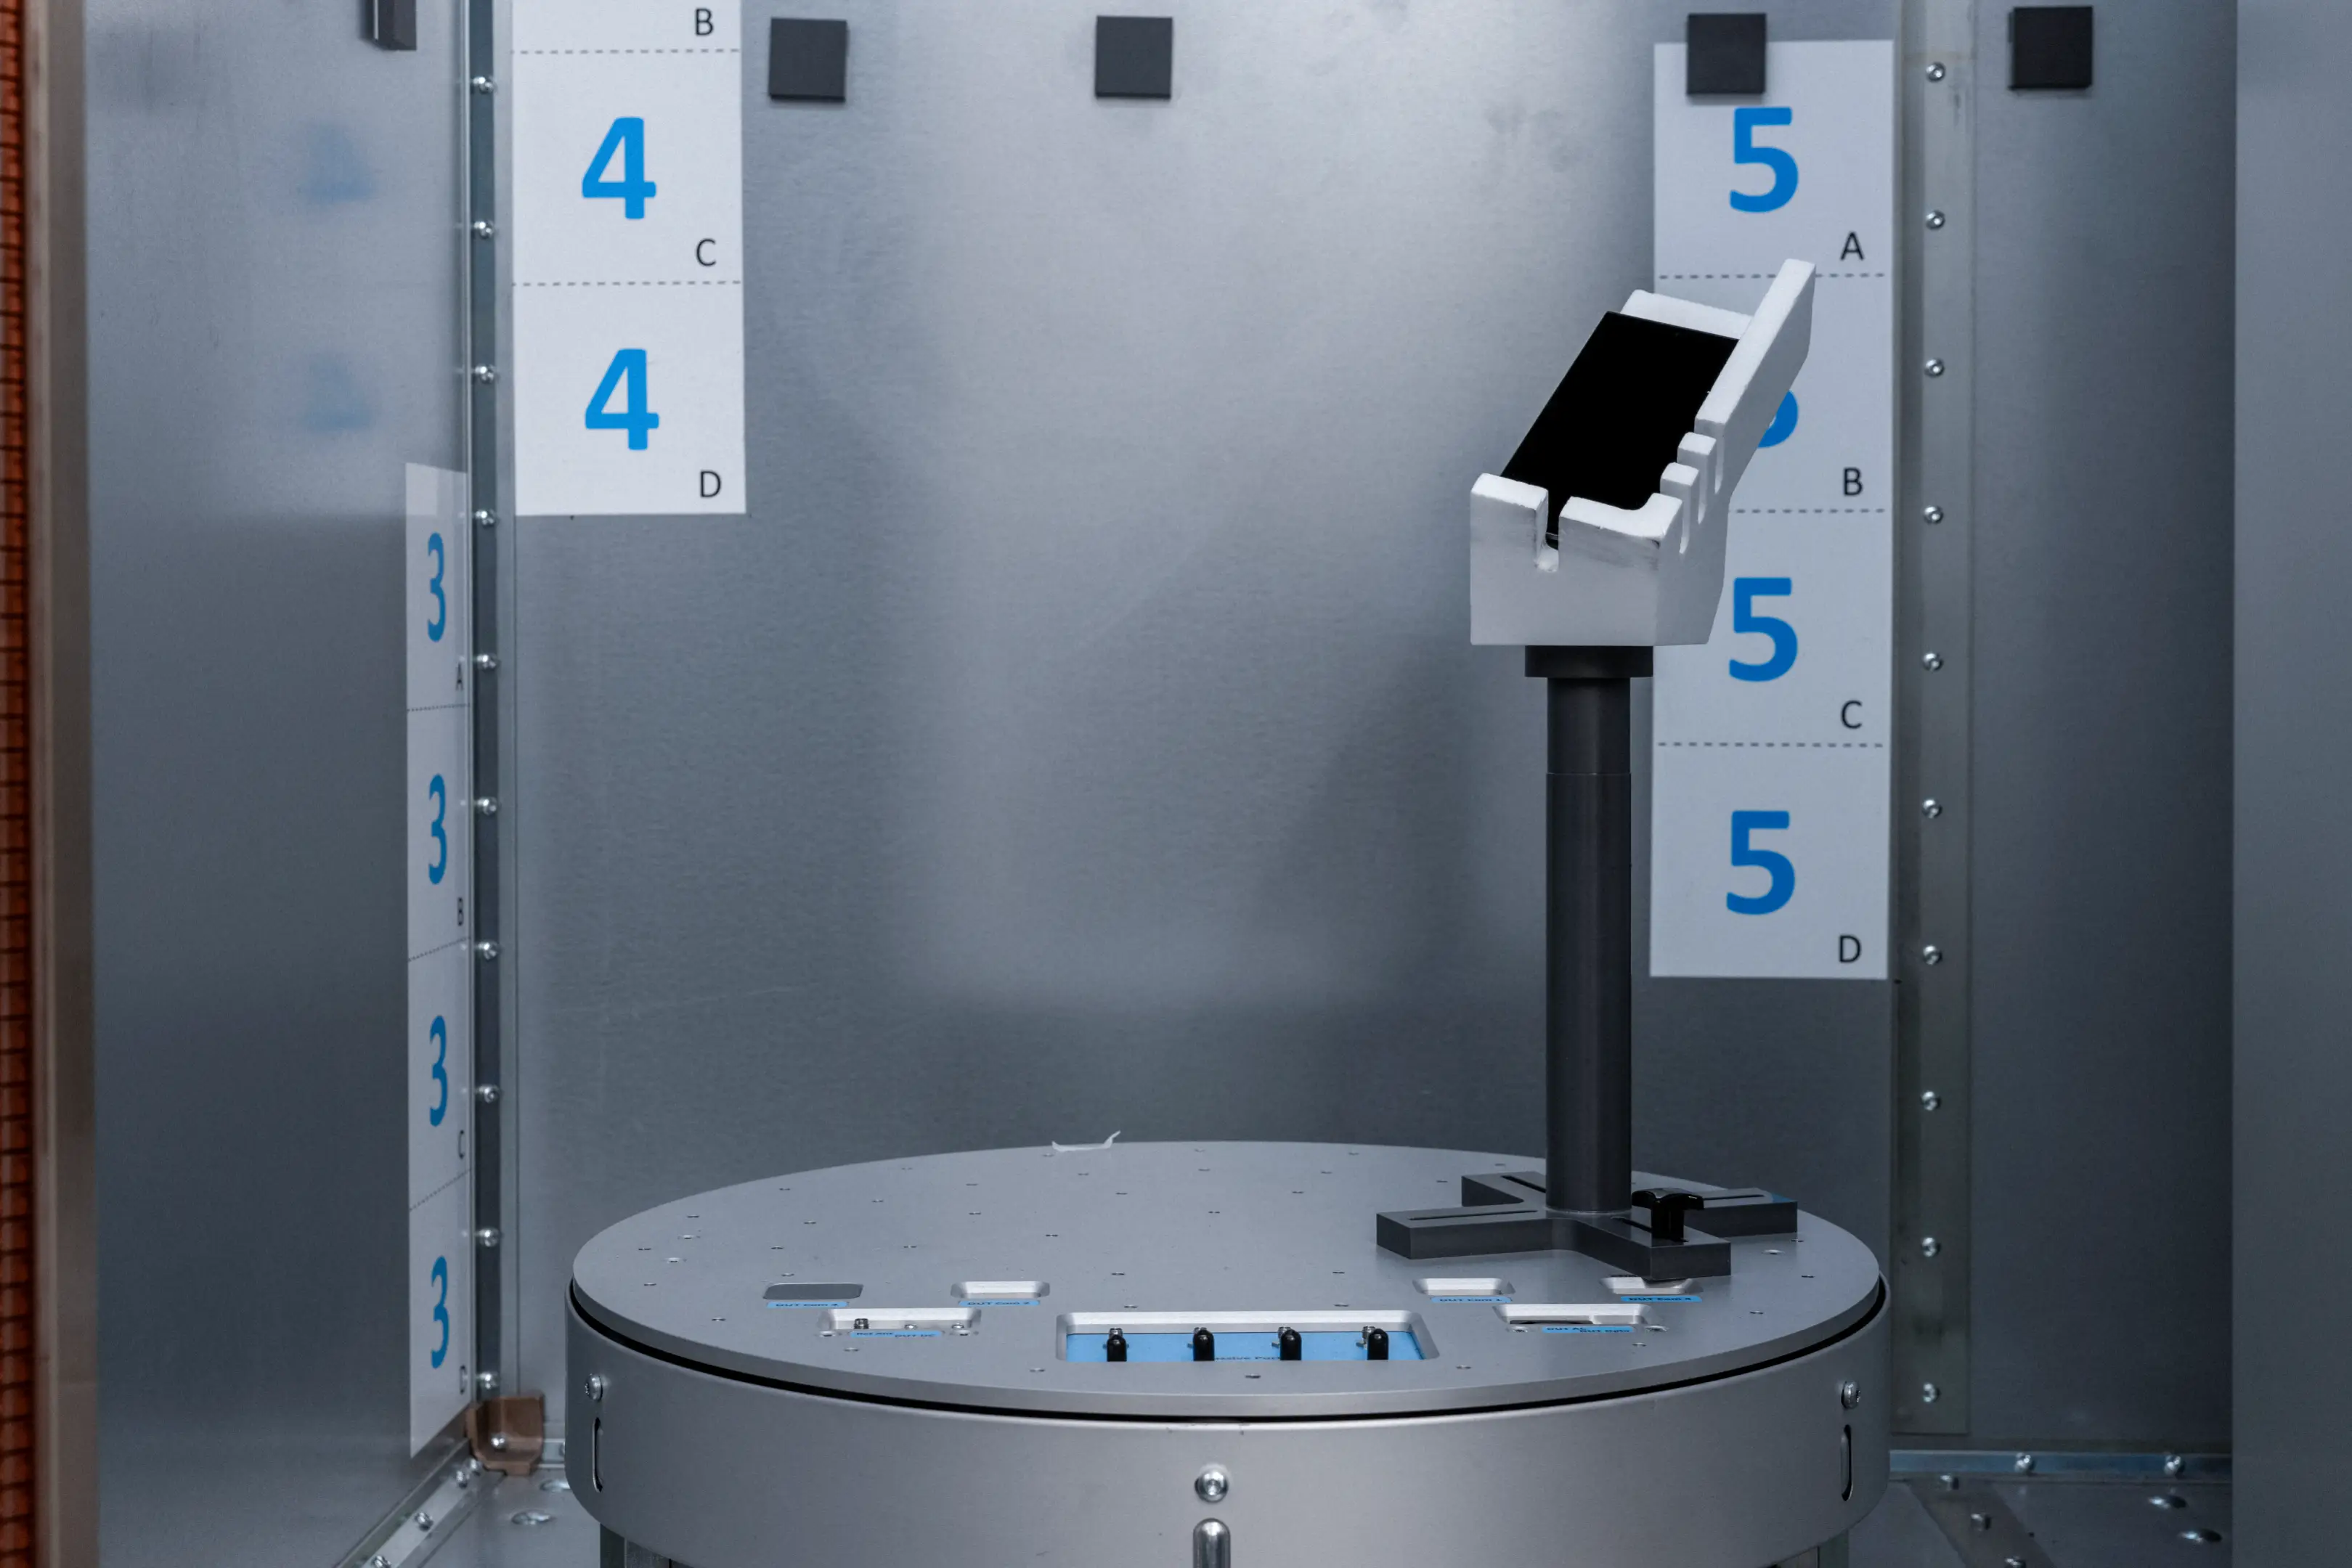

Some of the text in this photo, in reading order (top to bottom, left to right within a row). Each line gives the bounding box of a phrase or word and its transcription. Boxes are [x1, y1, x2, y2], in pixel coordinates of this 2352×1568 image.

[694, 7, 715, 37] B
[582, 117, 656, 219] 4
[1730, 107, 1799, 213] 5
[695, 237, 717, 268] C
[1840, 231, 1864, 261] A
[585, 348, 659, 450] 4
[699, 469, 723, 499] D
[1842, 467, 1864, 497] B
[428, 532, 447, 642] 3
[1729, 577, 1798, 682] 5
[455, 662, 463, 690] A
[1840, 699, 1863, 730] C
[428, 774, 447, 885] 3
[1726, 810, 1795, 915] 5
[457, 897, 464, 927] B
[1838, 934, 1863, 964] D
[429, 1015, 449, 1127] 3
[458, 1129, 465, 1159] C
[431, 1256, 449, 1368] 3
